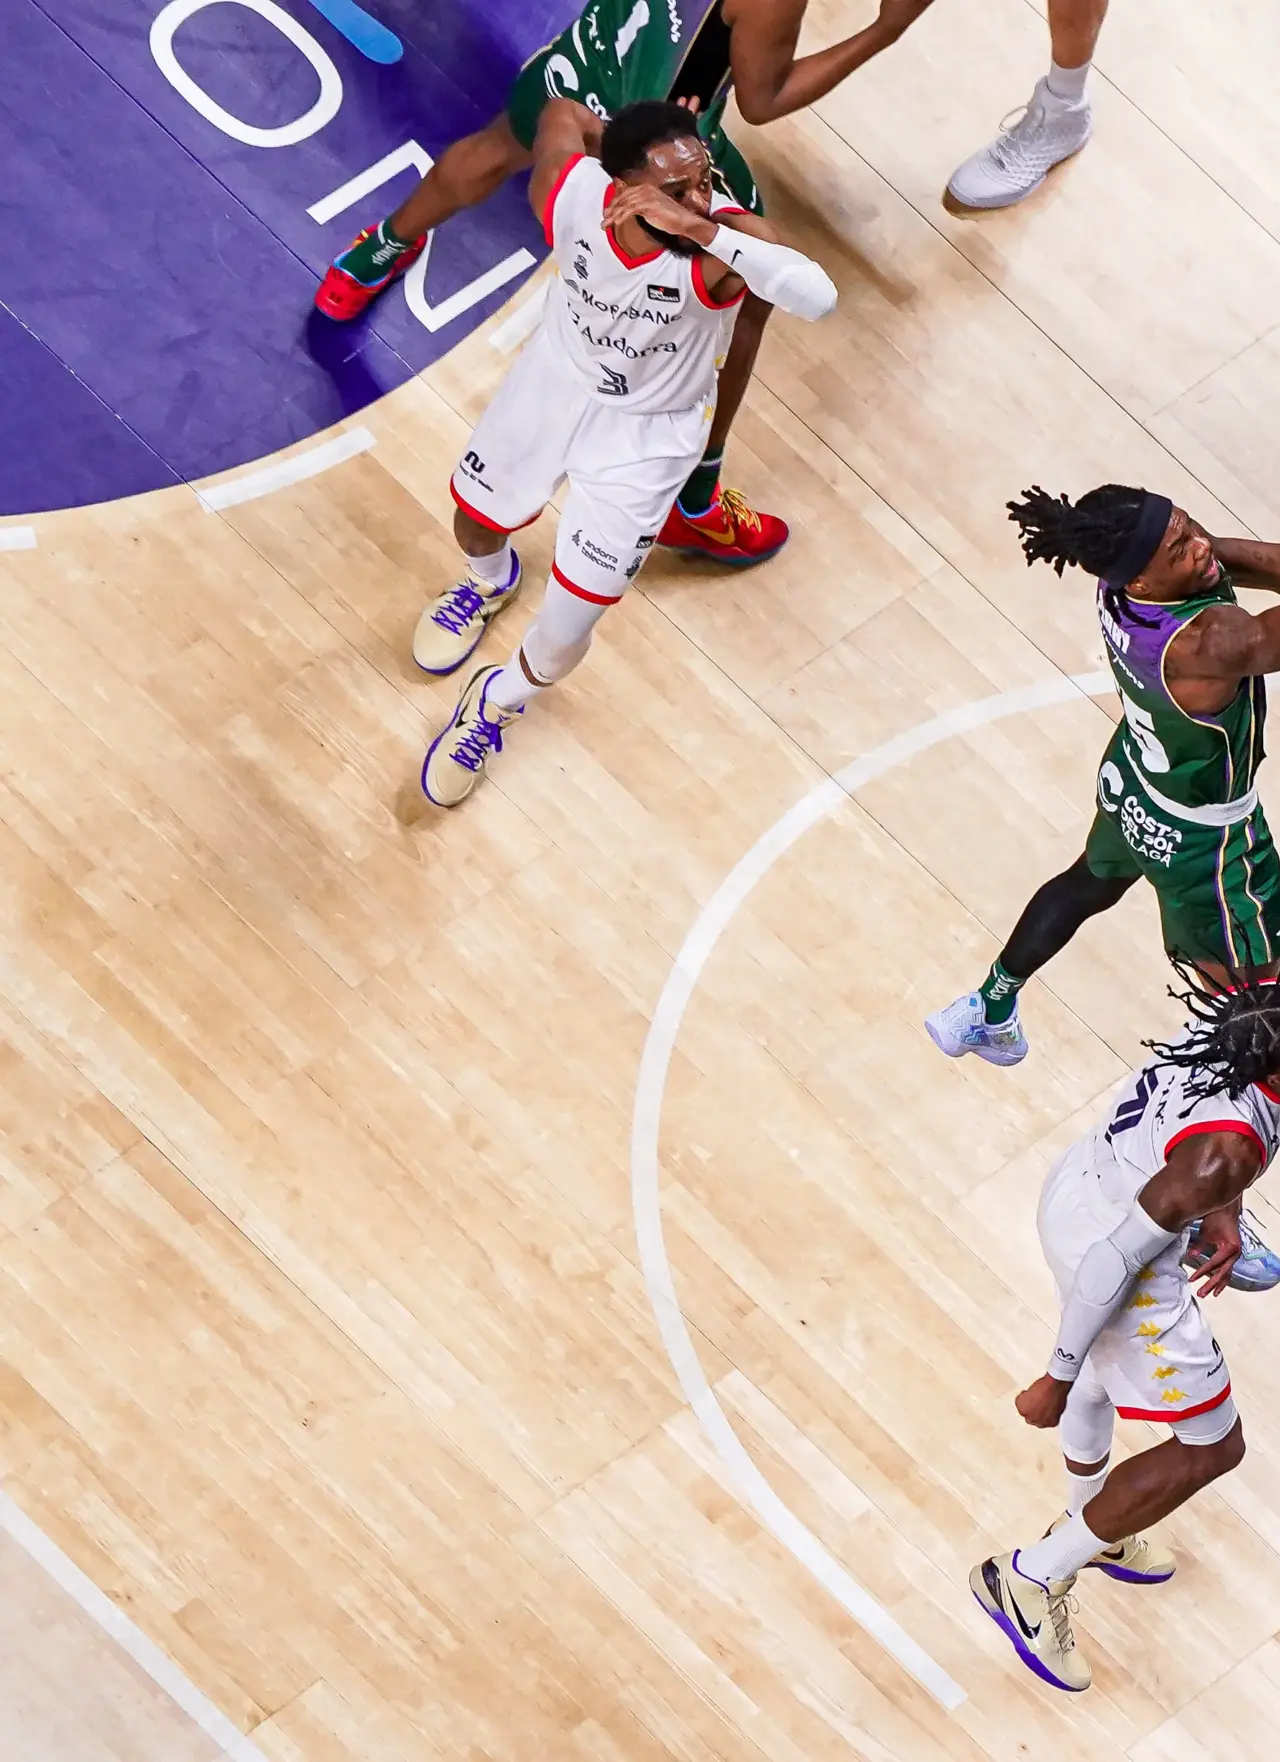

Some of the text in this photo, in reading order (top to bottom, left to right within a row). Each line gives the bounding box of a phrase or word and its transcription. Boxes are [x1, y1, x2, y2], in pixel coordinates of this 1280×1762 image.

[581, 325, 678, 360] Andorra
[581, 546, 617, 573] telecom
[584, 539, 619, 565] andorra
[1120, 806, 1177, 854] DEL SOL
[1124, 795, 1183, 843] COSTA
